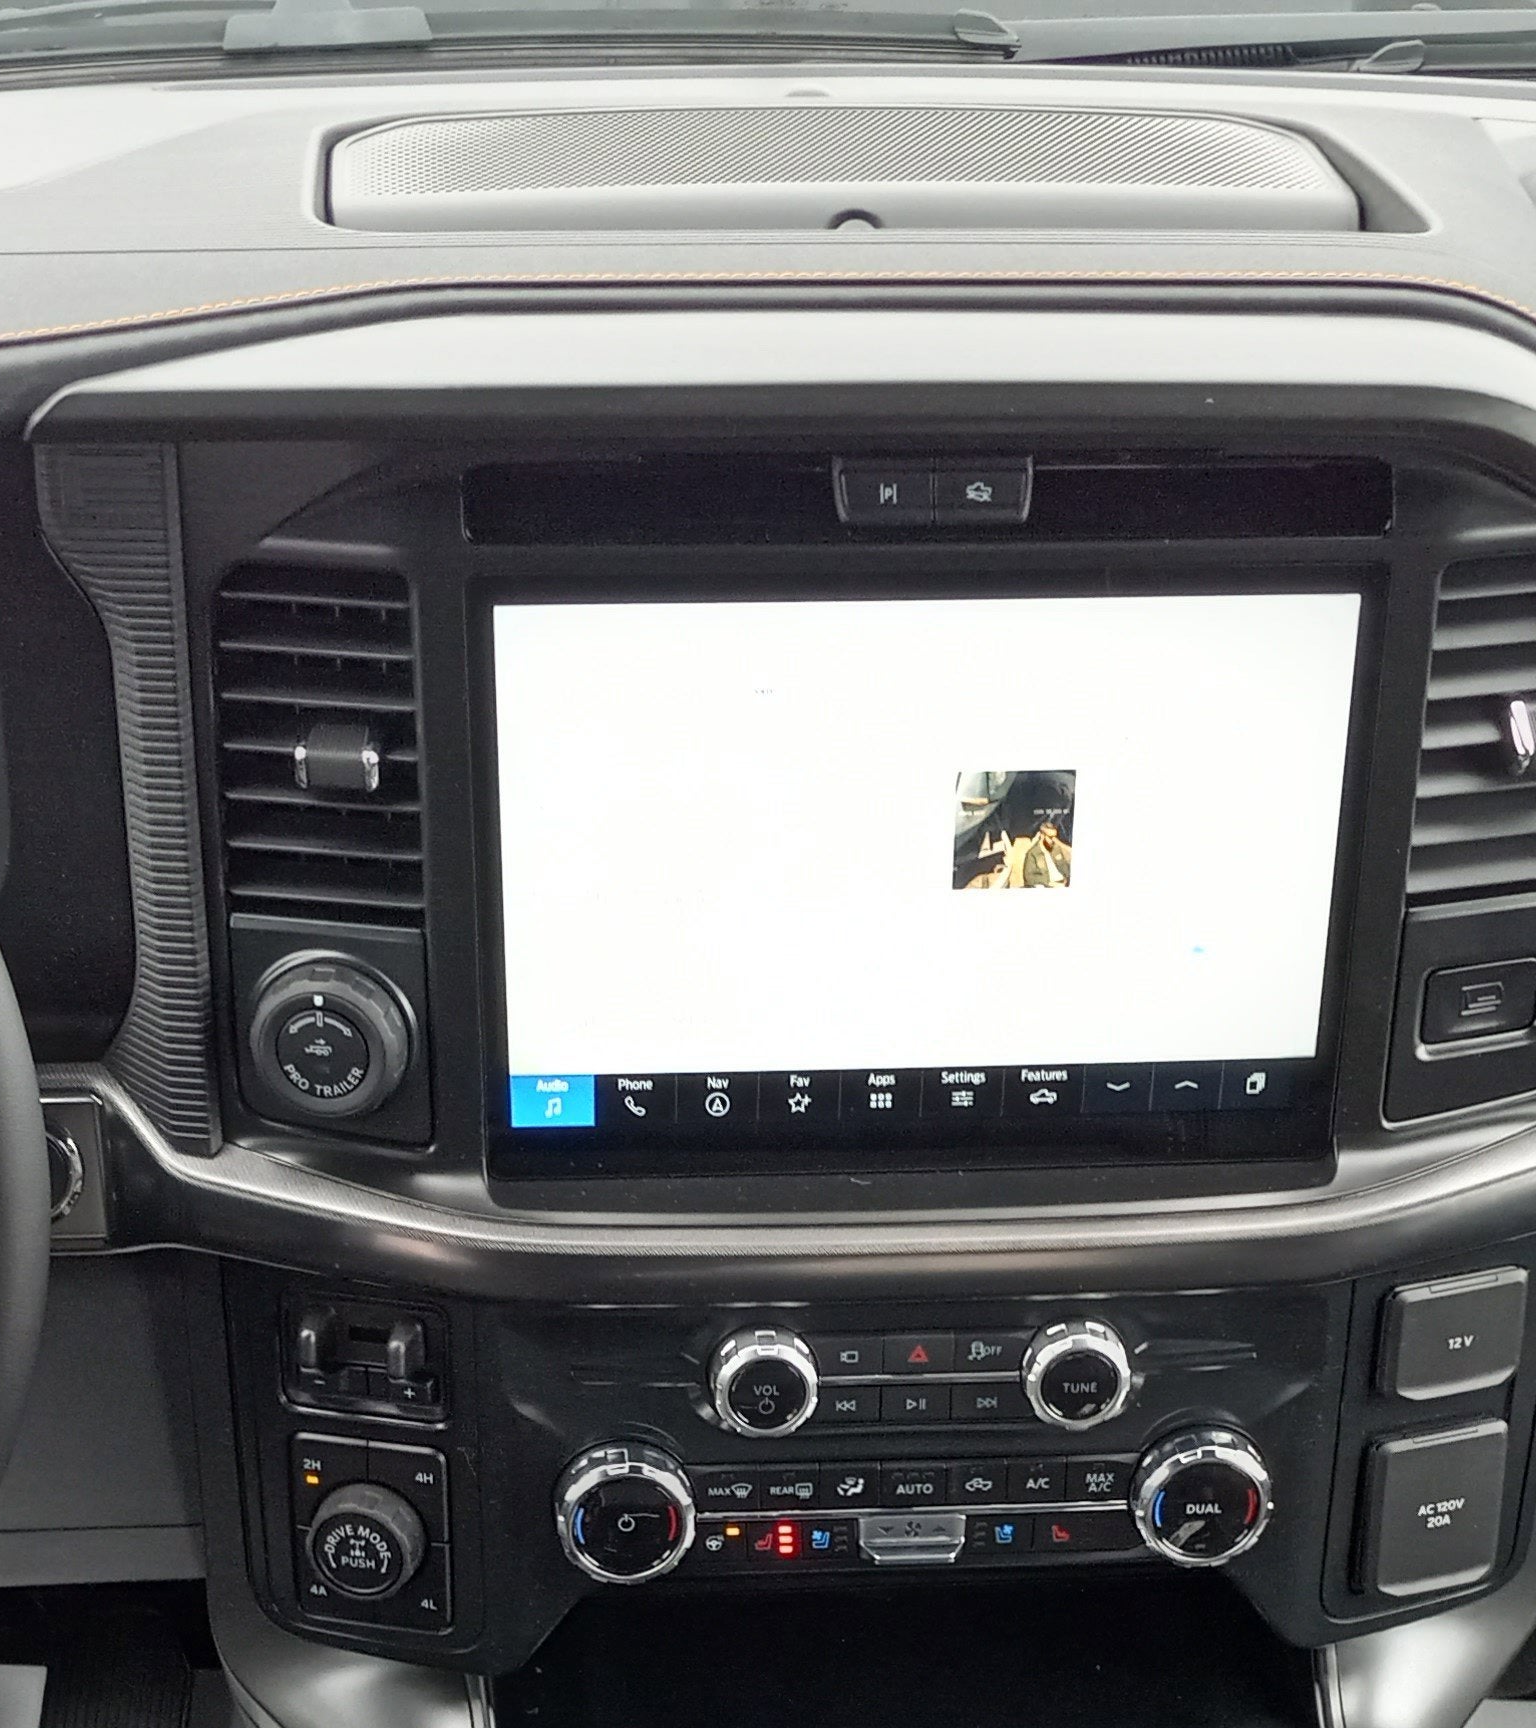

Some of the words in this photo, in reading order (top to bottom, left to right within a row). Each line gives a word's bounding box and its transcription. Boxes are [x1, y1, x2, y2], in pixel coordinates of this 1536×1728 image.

[283, 1063, 310, 1091] PRO
[314, 1066, 365, 1098] TRAILER
[789, 1074, 811, 1088] Fav
[867, 1072, 896, 1088] Apps
[941, 1070, 987, 1086] Settings
[1021, 1068, 1069, 1082] Features
[536, 1078, 570, 1093] Audio
[617, 1077, 654, 1092] Phone
[707, 1076, 730, 1090] Nav
[983, 1345, 1003, 1356] OFF
[752, 1384, 781, 1397] VOL
[1062, 1380, 1098, 1395] TUNE
[303, 1458, 322, 1472] 2H
[414, 1472, 434, 1485] 4H
[1025, 1477, 1051, 1491] A/C
[1085, 1472, 1115, 1484] MAX
[707, 1486, 732, 1497] MAX
[769, 1486, 794, 1496] REAR
[895, 1483, 934, 1496] AUTO
[1087, 1482, 1113, 1494] A/C
[1185, 1502, 1223, 1516] DUAL
[1417, 1503, 1435, 1518] AC
[1435, 1497, 1467, 1513] 120V
[1426, 1513, 1452, 1529] 20A
[323, 1523, 356, 1555] DRIVE
[356, 1524, 392, 1561] MODE
[340, 1555, 376, 1571] PUSH
[309, 1583, 329, 1597] 4A
[420, 1598, 439, 1612] 4L
